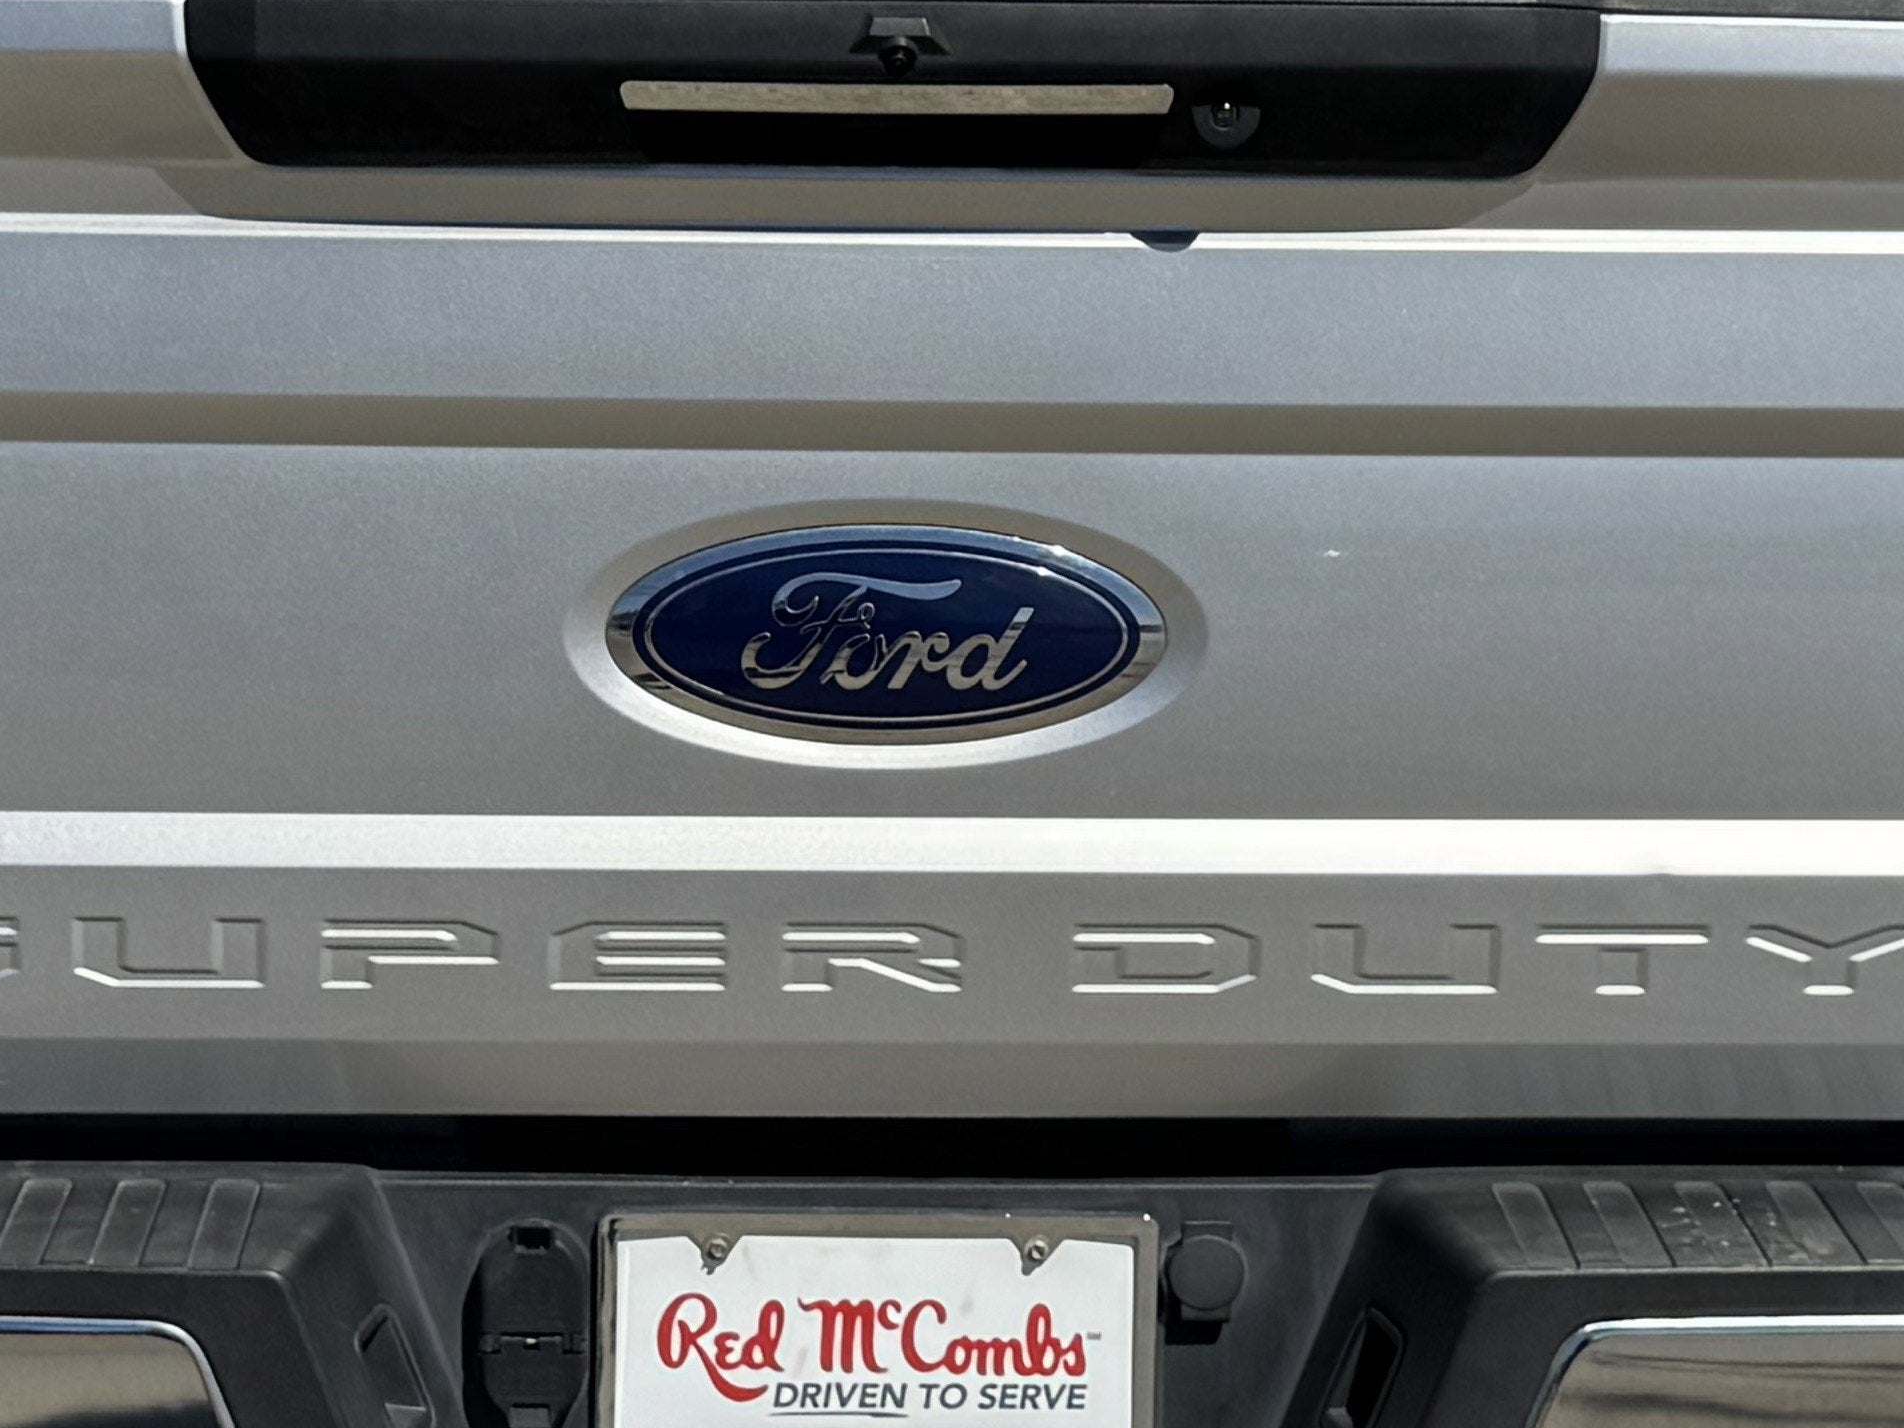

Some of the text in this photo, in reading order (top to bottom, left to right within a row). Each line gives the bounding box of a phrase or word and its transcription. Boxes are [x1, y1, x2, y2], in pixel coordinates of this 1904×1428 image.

[740, 572, 1029, 692] Ford
[656, 1292, 1087, 1403] Red McCombs
[771, 1382, 1088, 1411] DRIVEN TO SERVE
